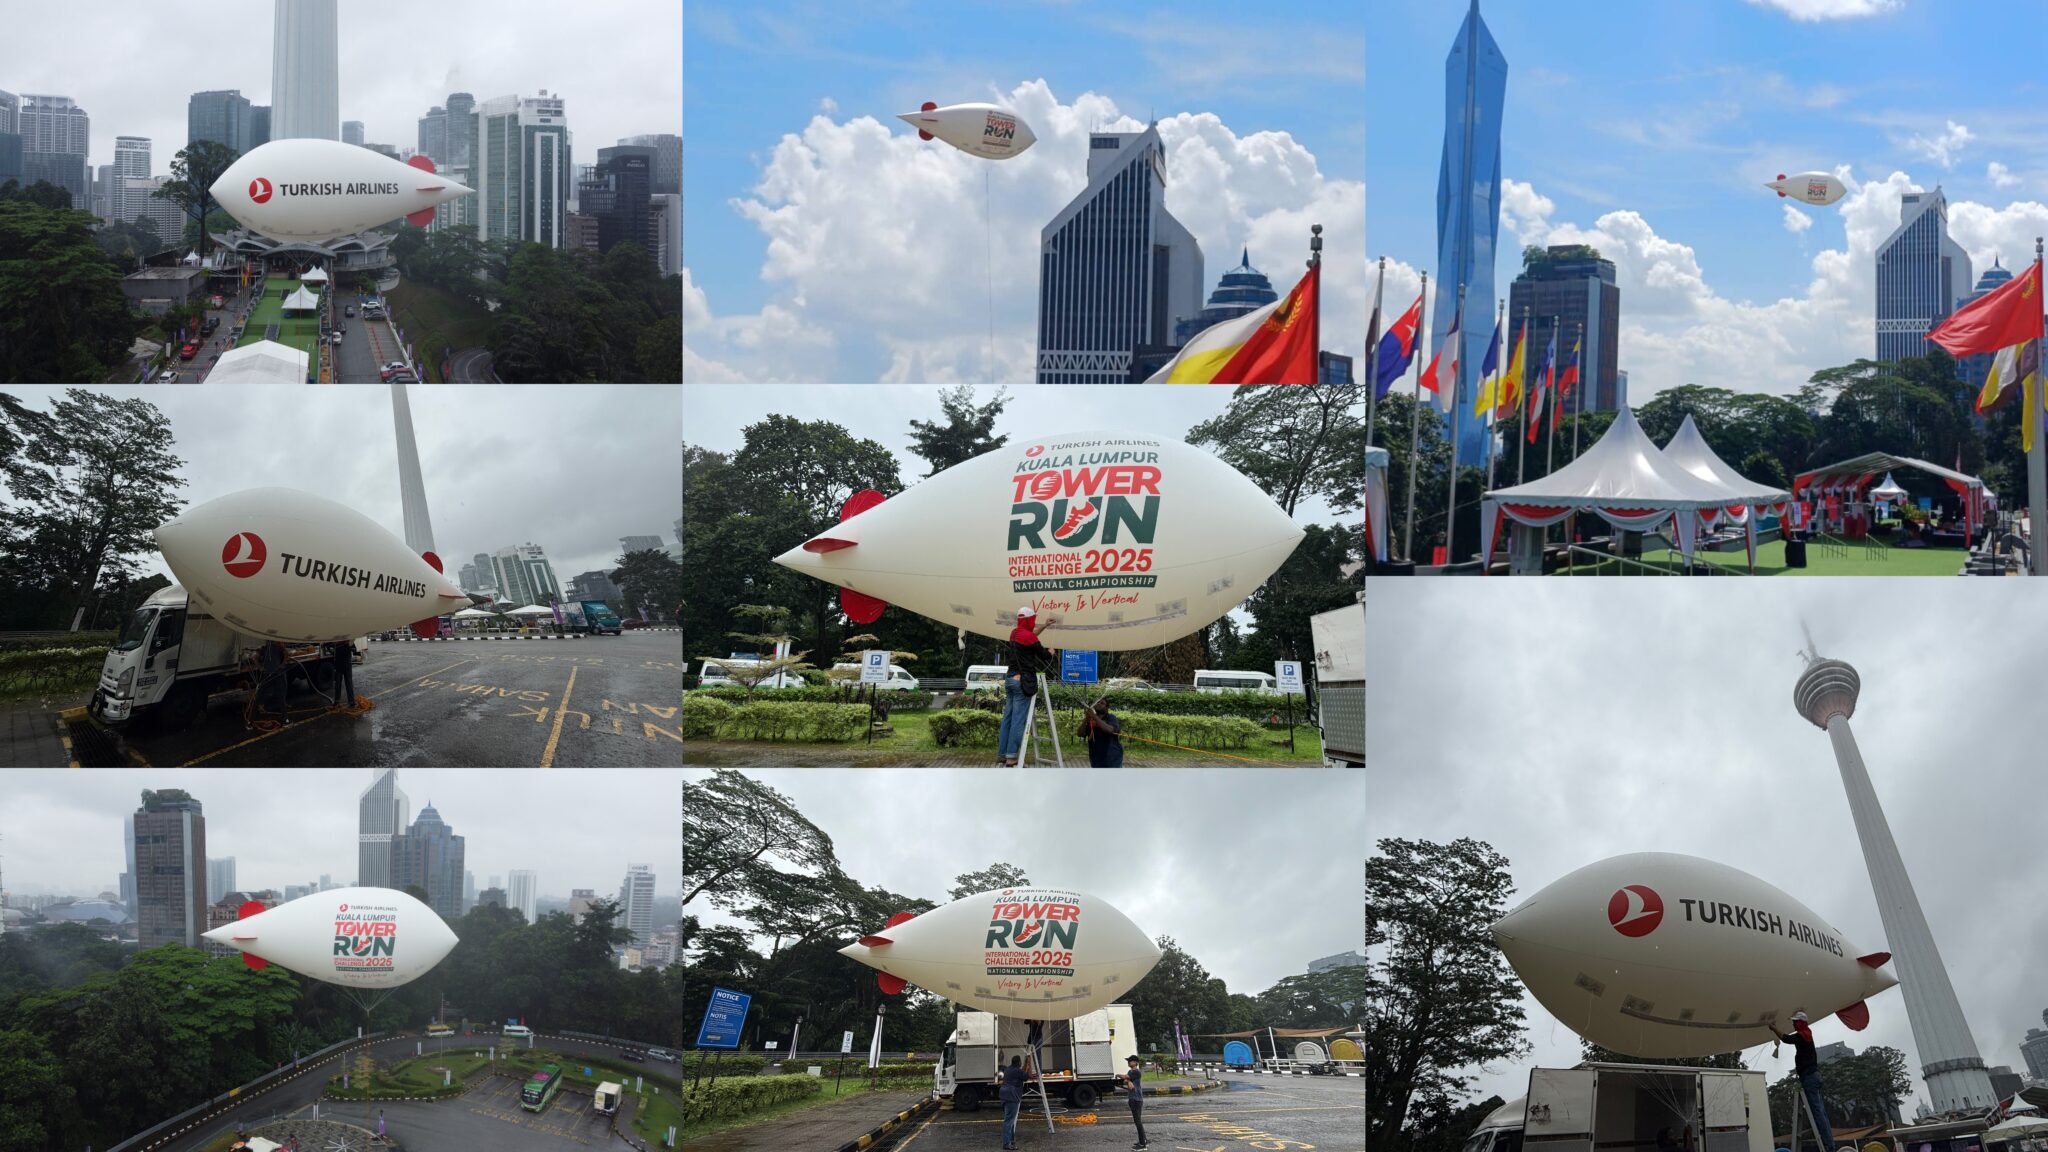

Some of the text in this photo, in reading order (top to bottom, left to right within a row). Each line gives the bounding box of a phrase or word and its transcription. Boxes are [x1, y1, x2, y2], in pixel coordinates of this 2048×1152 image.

[984, 125, 1015, 139] RUN
[280, 182, 399, 197] TURKISH AIRLINES
[1051, 440, 1101, 451] TURKISH
[1016, 451, 1159, 473] KUALA LUMPUR
[1012, 465, 1162, 503] TOWER
[1007, 496, 1161, 551] RUN
[1008, 553, 1082, 566] INTERNATIONAL
[1009, 548, 1153, 577] CHALLENGE 2025
[281, 552, 426, 598] TURKISH AIRLINES
[1014, 577, 1154, 591] NATIONAL CHAMPIONSHIP
[1032, 590, 1139, 613] Victory Is Vertical
[995, 895, 1079, 904] KUALA LUMPUR
[335, 913, 361, 921] KUALA
[992, 903, 1081, 921] TOWER
[335, 921, 397, 936] TOWER
[985, 919, 1079, 950] RUN
[1679, 898, 1844, 958] TURKISH AIRLINES
[333, 935, 396, 957] RUN
[366, 957, 393, 967] 2025
[985, 950, 1073, 966] CHALLENGE 2025
[716, 991, 740, 1001] NOTICE
[709, 1012, 727, 1020] NOTIS
